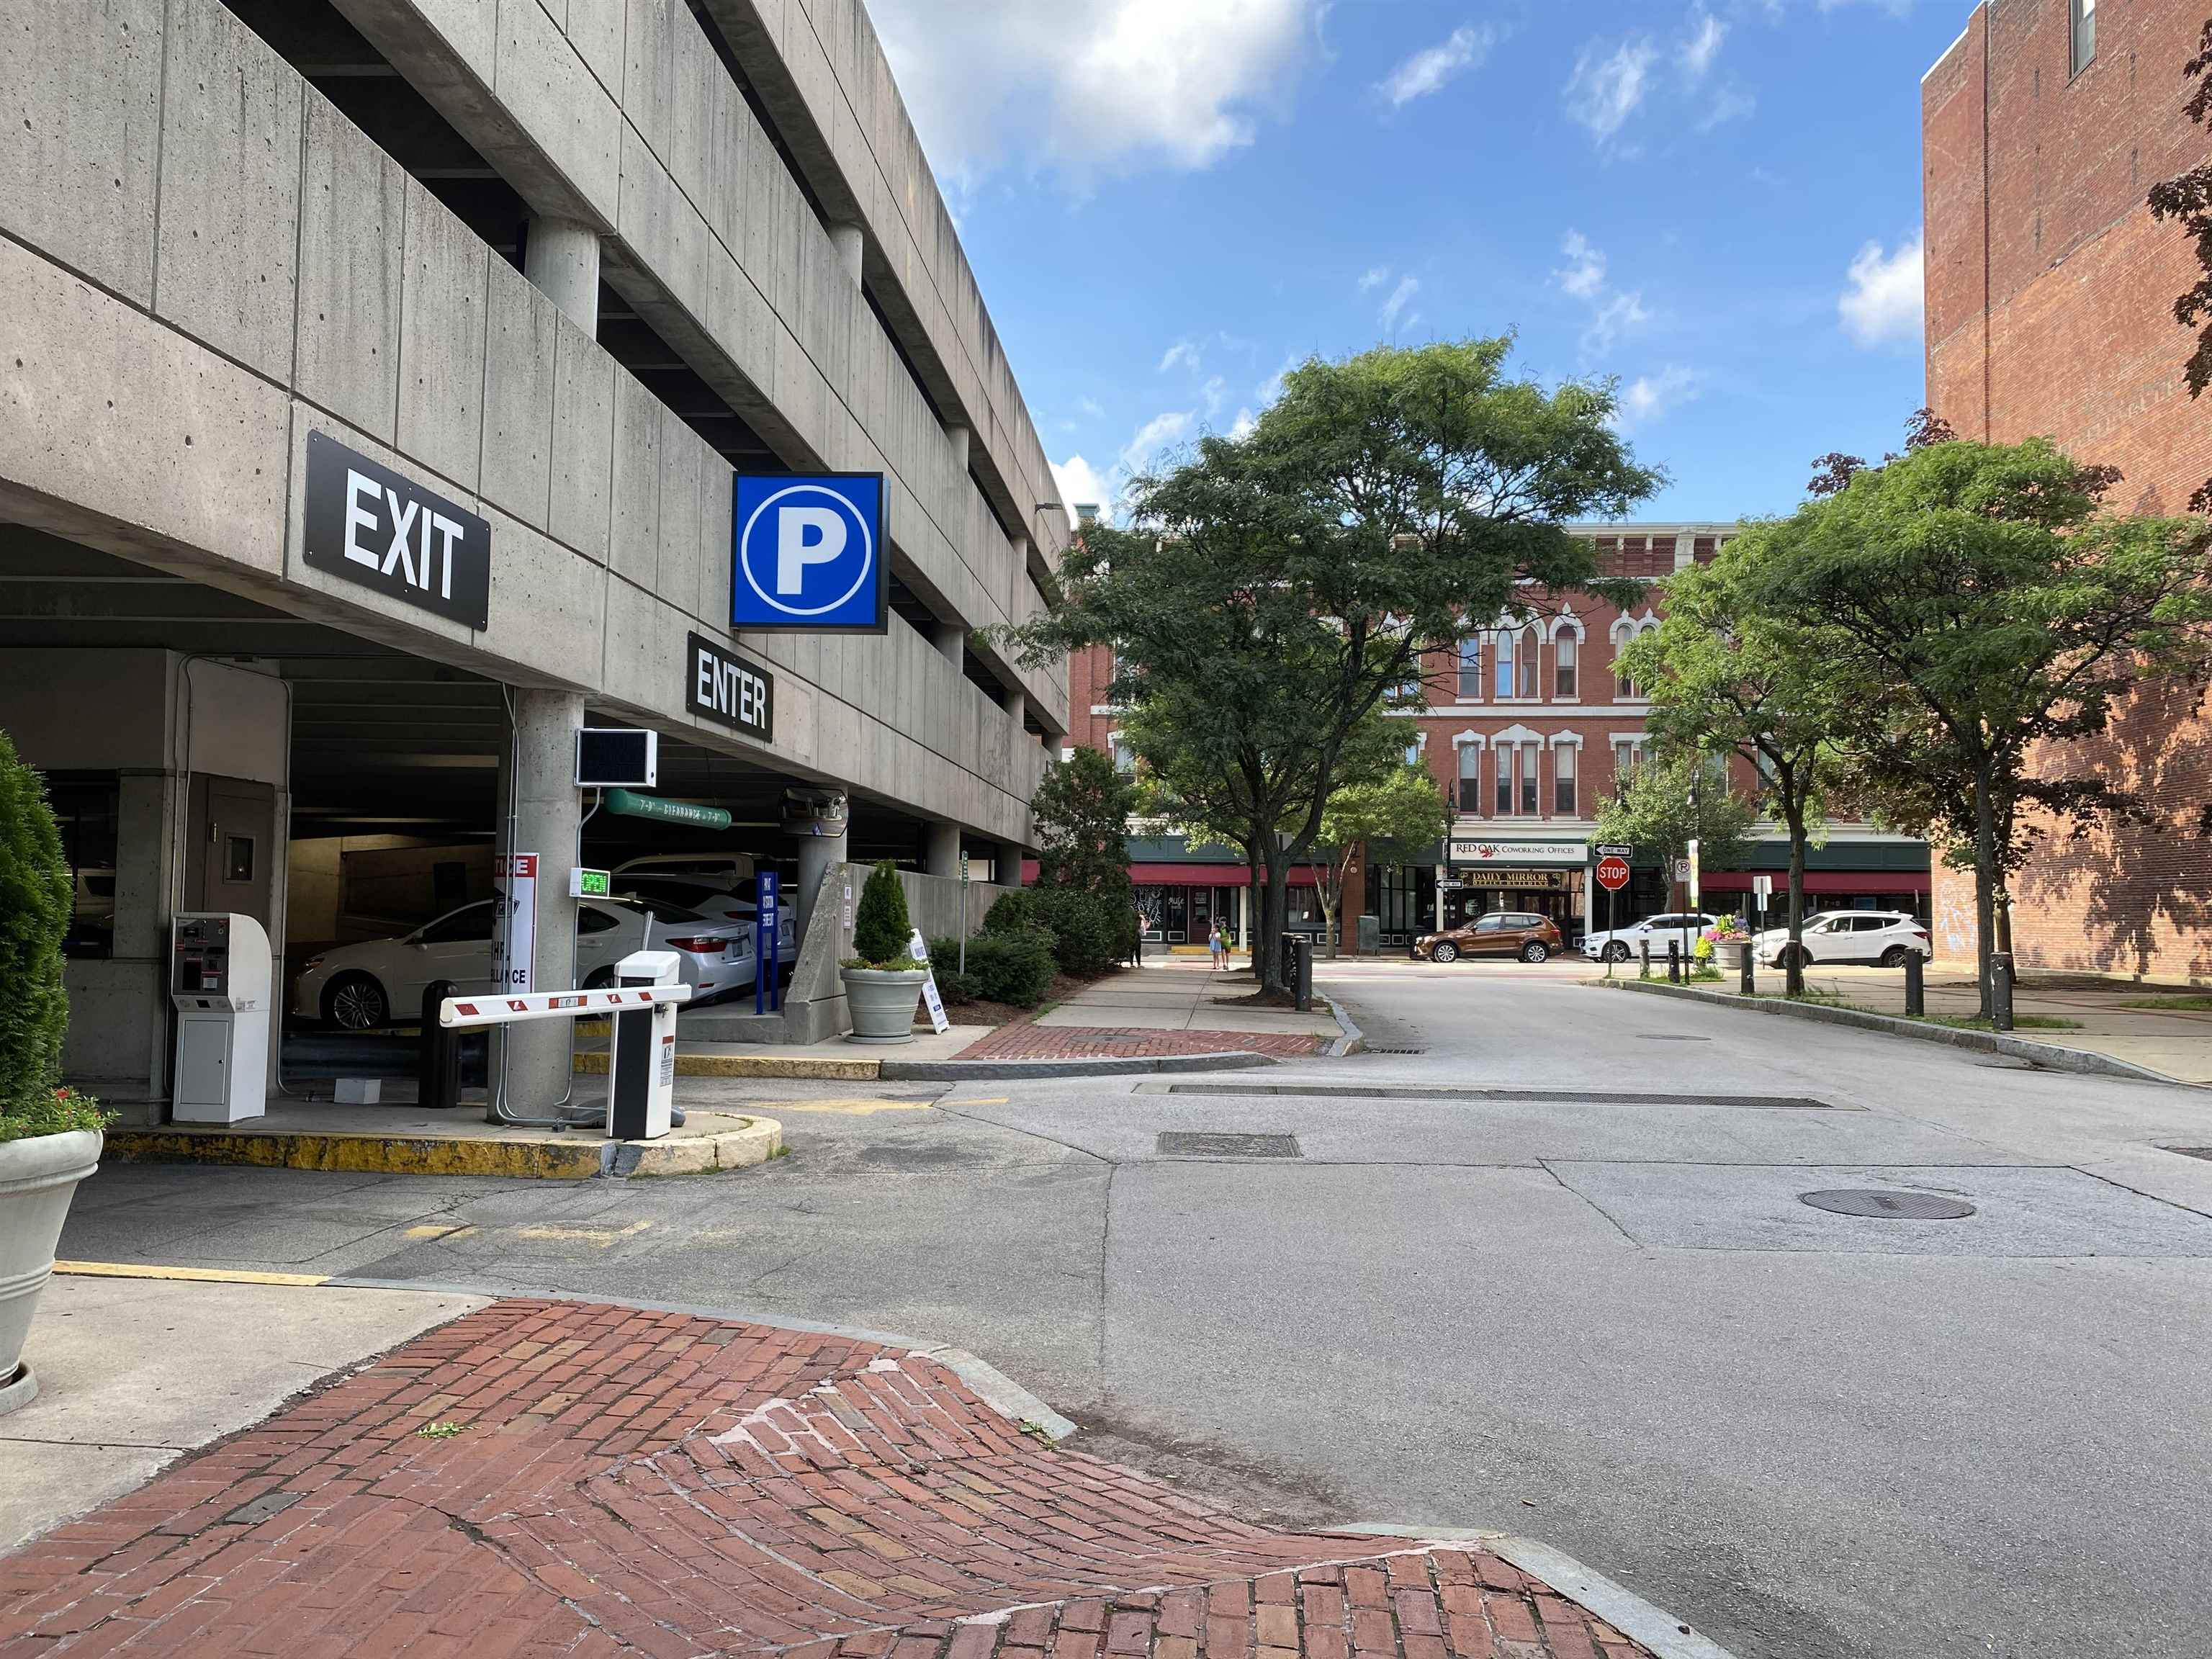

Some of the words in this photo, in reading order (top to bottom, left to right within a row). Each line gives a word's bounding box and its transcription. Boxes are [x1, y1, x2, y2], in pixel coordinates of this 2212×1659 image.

[343, 467, 464, 600] EXIT
[776, 506, 848, 595] P
[697, 648, 766, 729] ENTER
[663, 804, 701, 819] CLEARANCE
[1456, 844, 1477, 853] RED
[1478, 844, 1500, 853] OAK
[582, 873, 606, 892] OPEN
[1599, 867, 1627, 879] STOP
